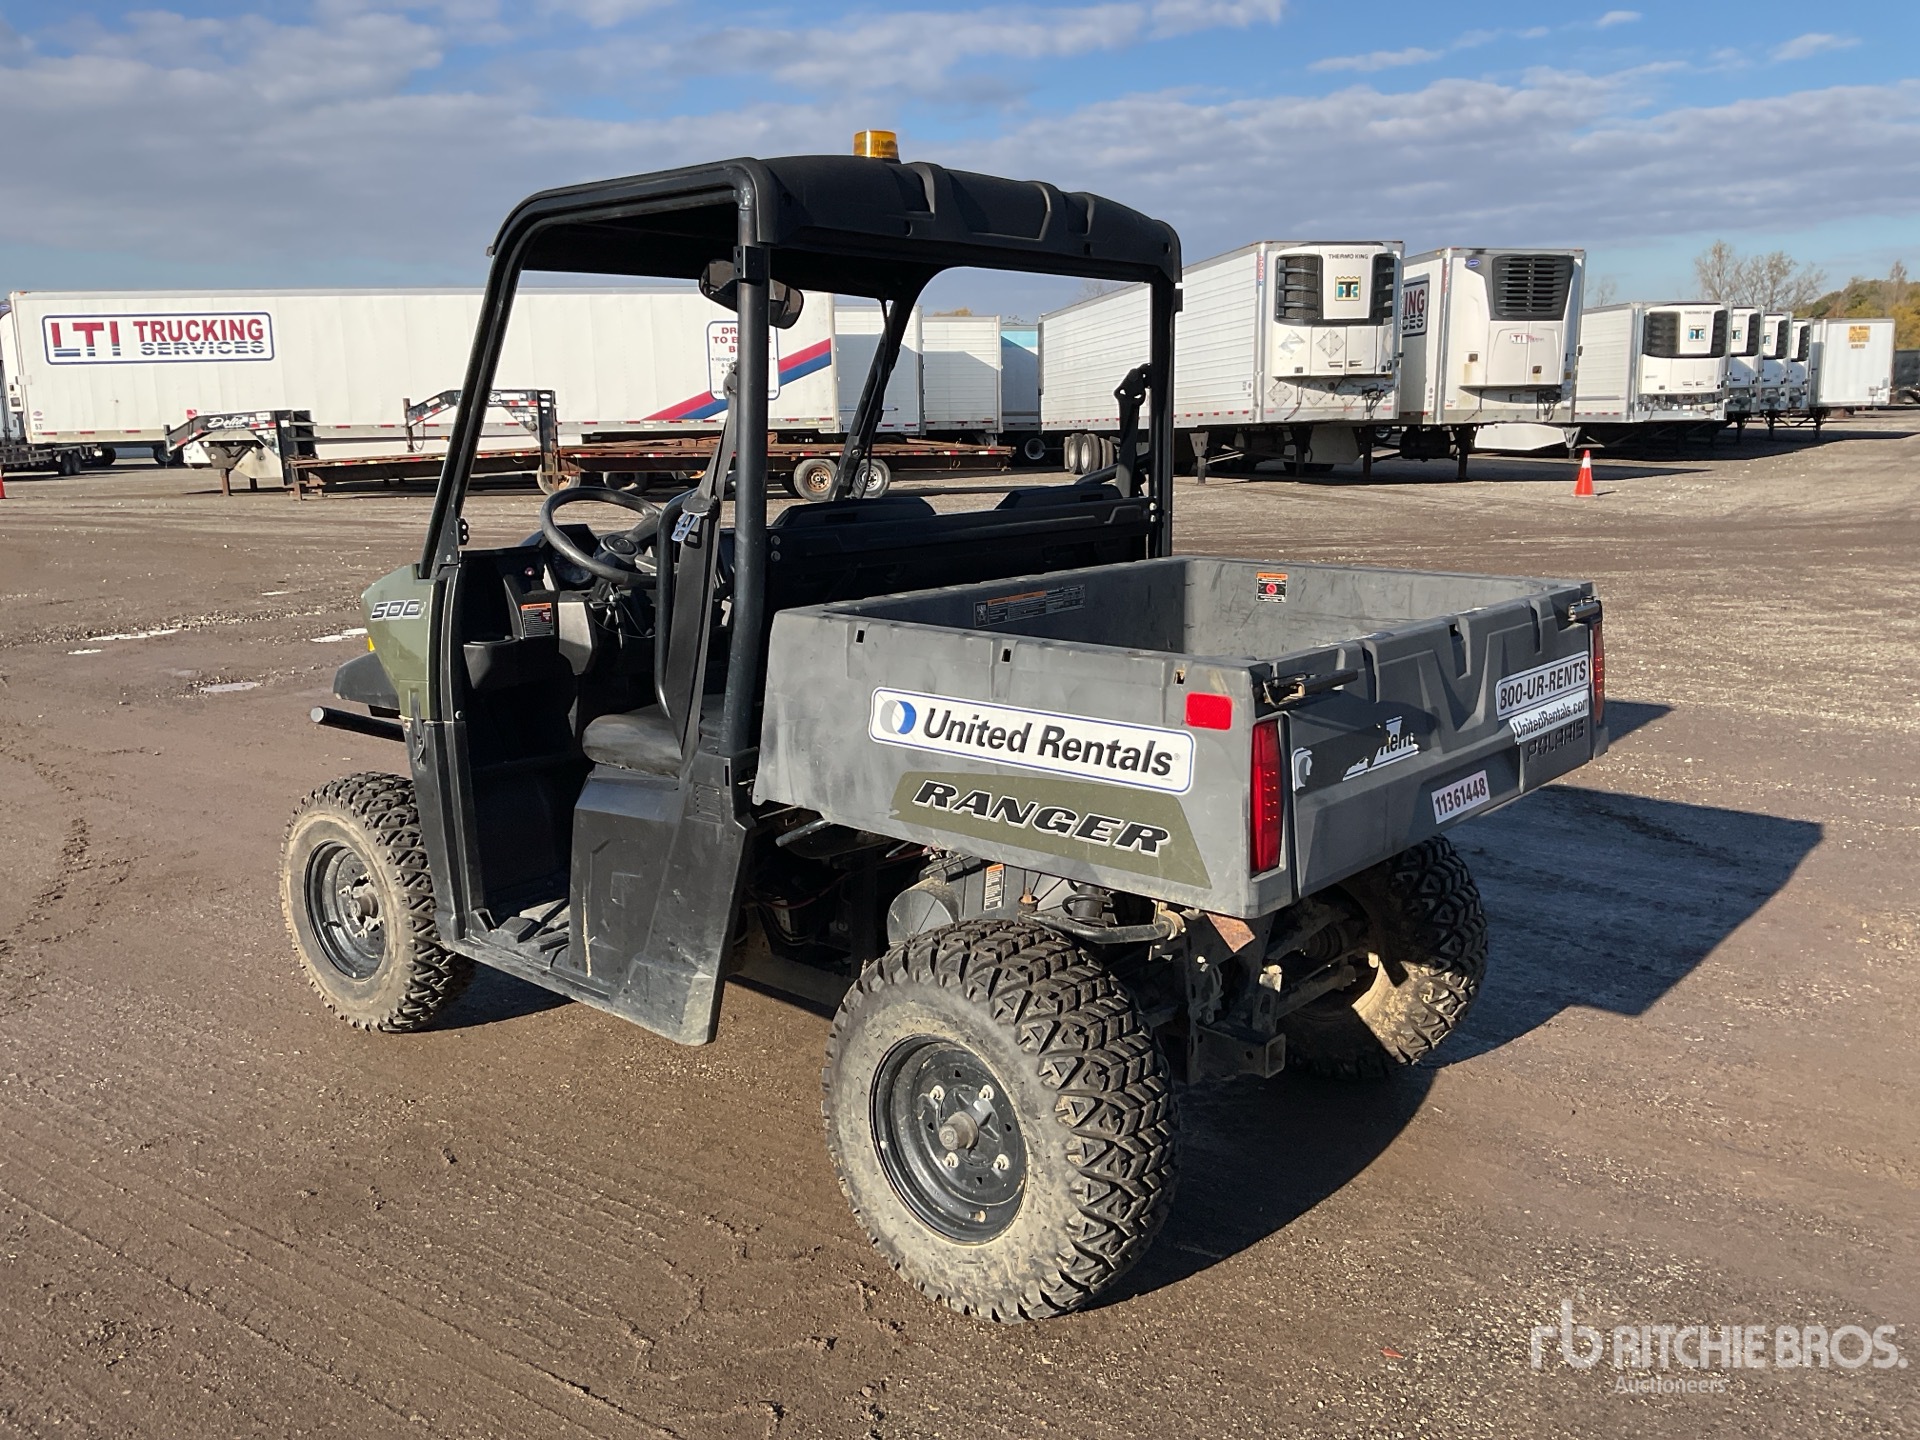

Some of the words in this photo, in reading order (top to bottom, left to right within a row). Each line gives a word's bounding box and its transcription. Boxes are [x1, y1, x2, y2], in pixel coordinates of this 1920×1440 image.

[51, 321, 122, 357] LTI
[133, 319, 264, 343] TRUCKING
[141, 341, 265, 356] SERVICES
[1500, 660, 1587, 711] 800-UR-RENTS
[923, 707, 1033, 753] United
[1435, 777, 1487, 816] 11361448
[912, 780, 1171, 857] RANGER
